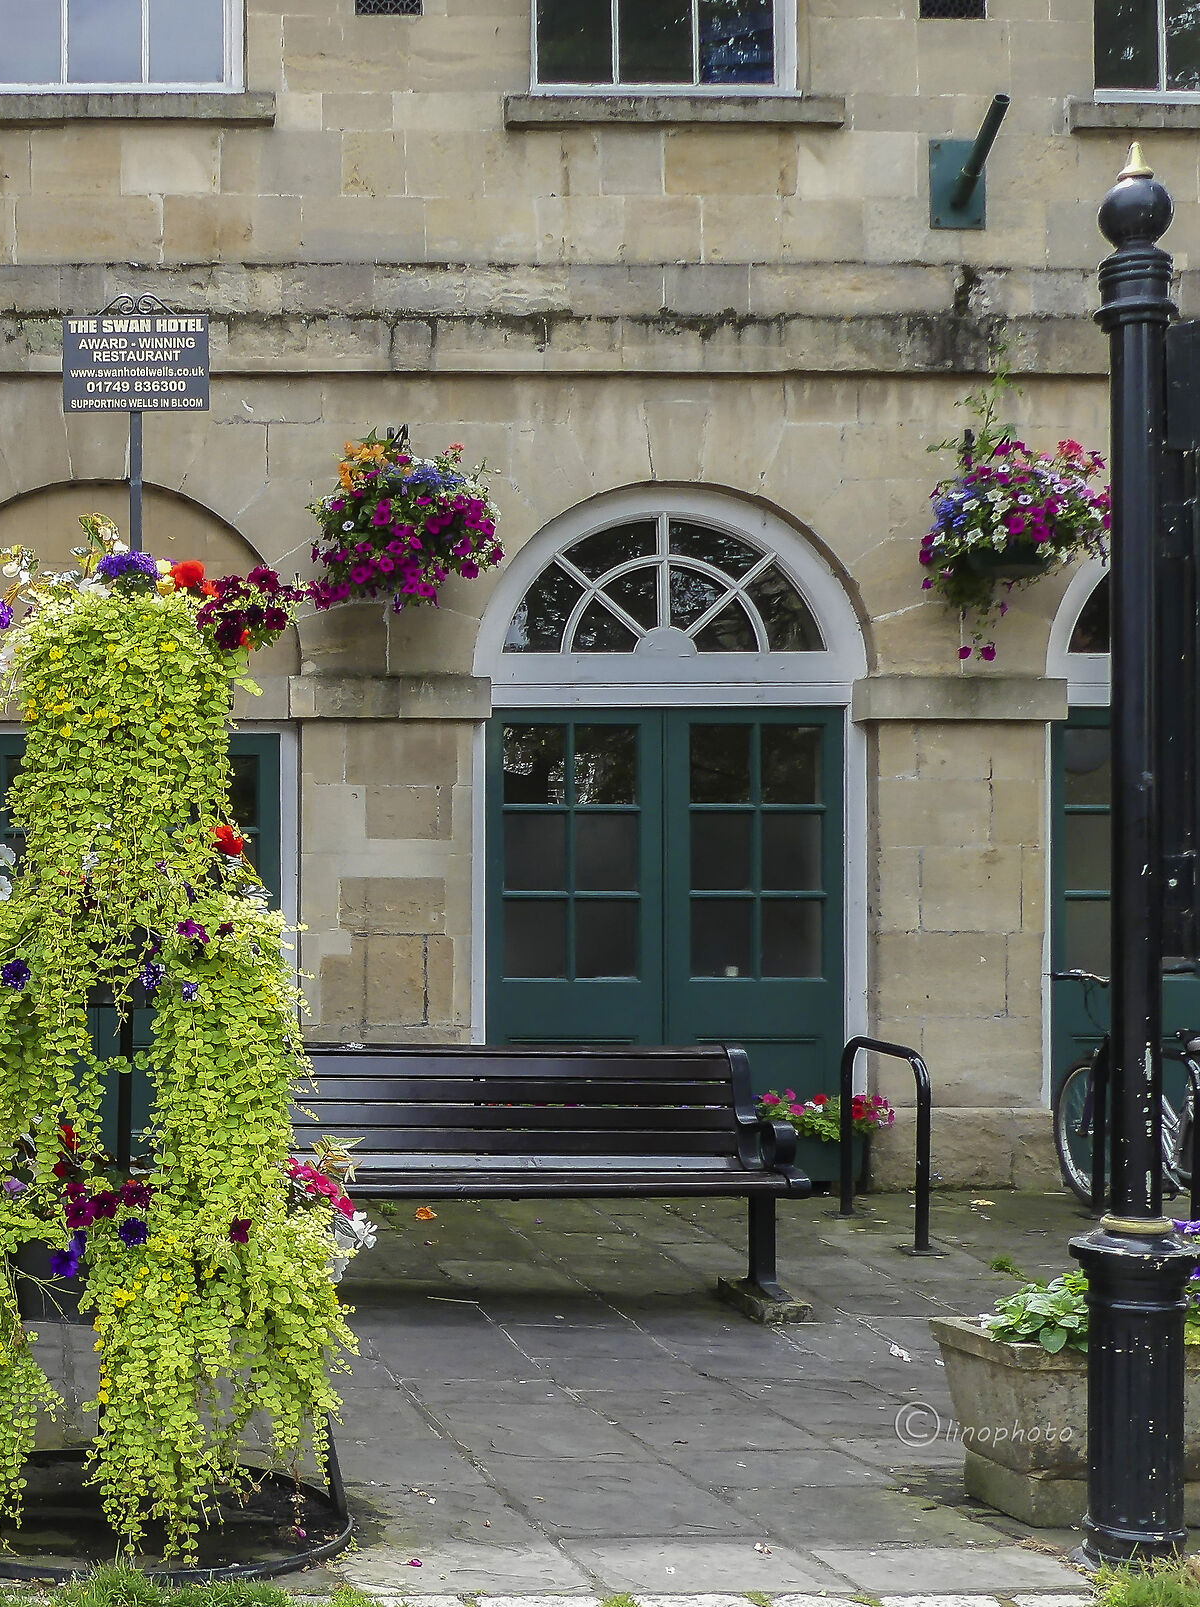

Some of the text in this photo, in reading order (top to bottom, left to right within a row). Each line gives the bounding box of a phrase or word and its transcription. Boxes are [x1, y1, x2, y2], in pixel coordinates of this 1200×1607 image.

[68, 318, 204, 334] THE SWAN HOTEL
[78, 338, 128, 350] AWARD
[138, 337, 196, 349] WINNING
[93, 350, 181, 362] RESTAURANT
[69, 366, 205, 378] www.swanhotelwells.co.uk
[86, 380, 187, 393] 01749 836300
[70, 398, 203, 409] SUPPORTING WELLS IN BLOOM
